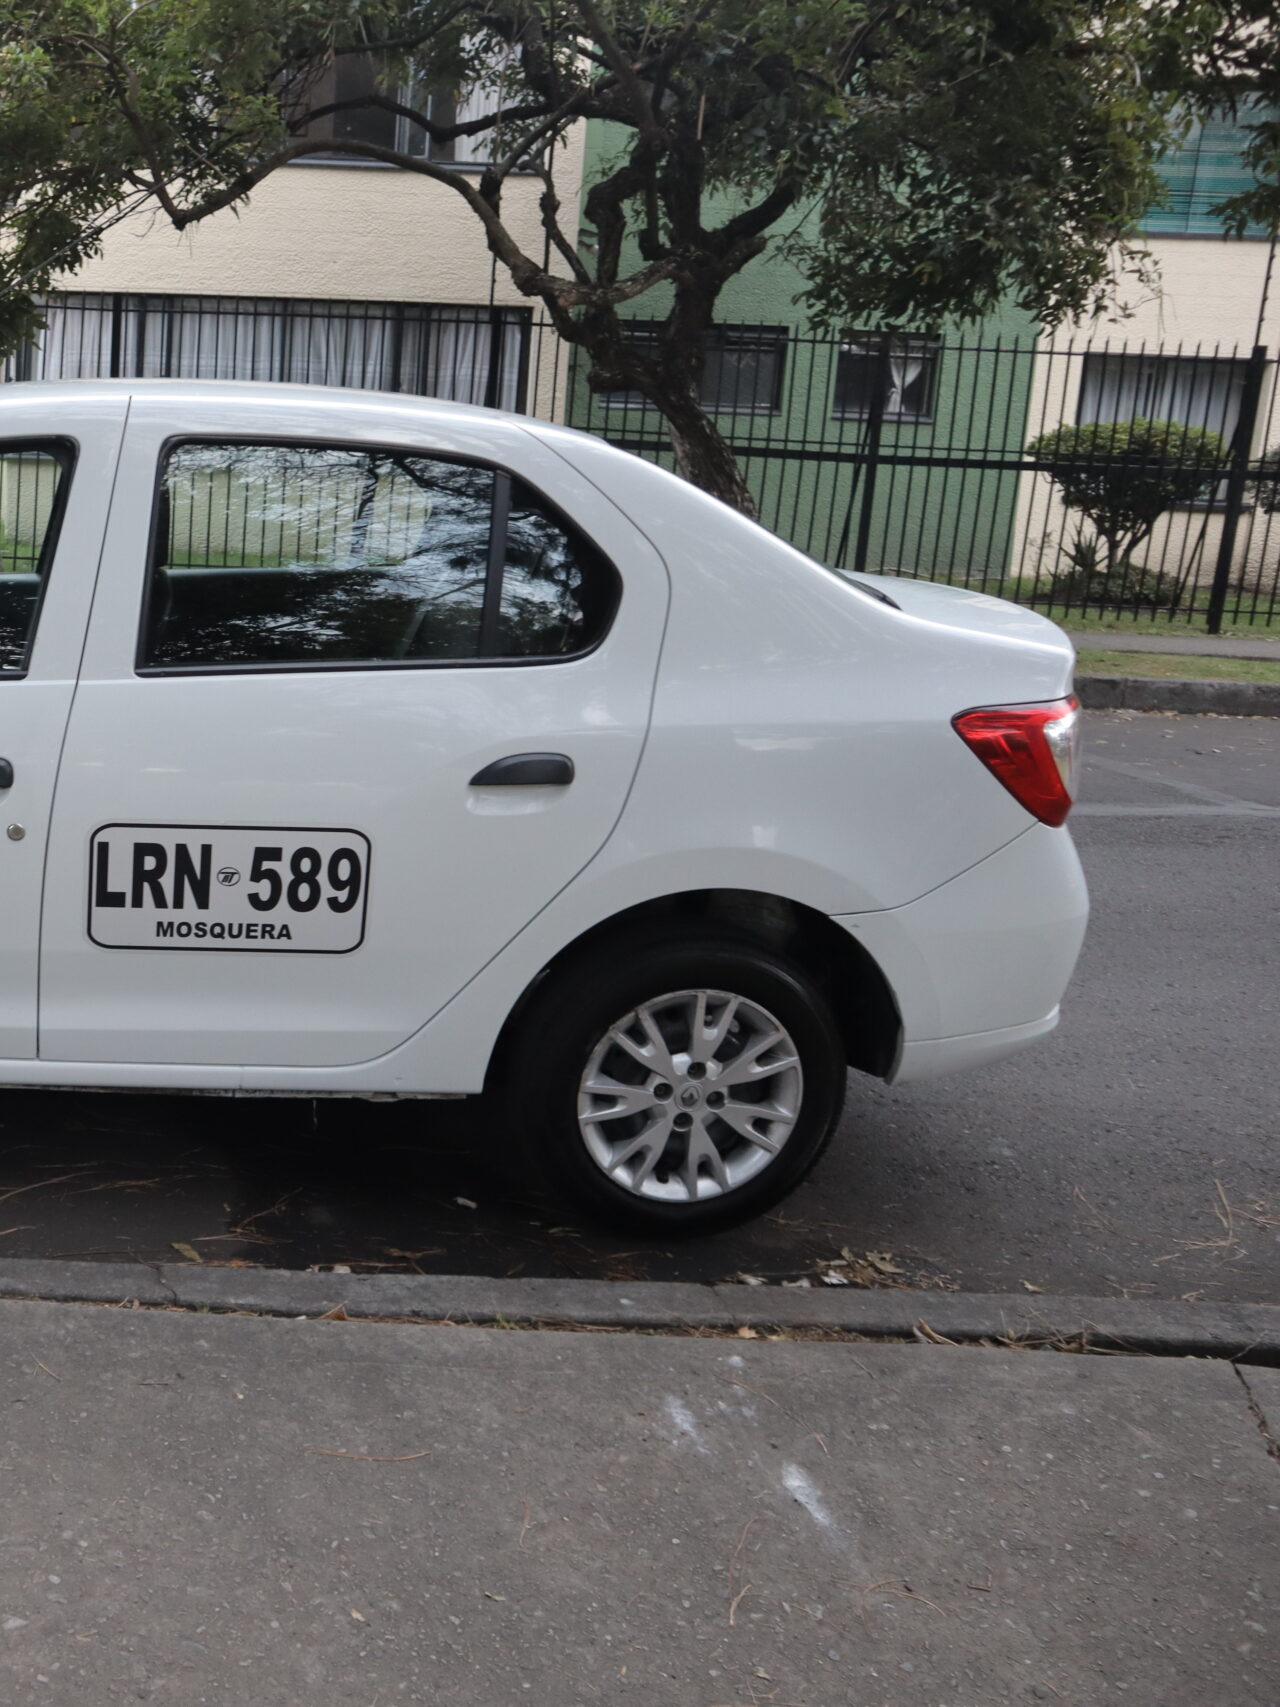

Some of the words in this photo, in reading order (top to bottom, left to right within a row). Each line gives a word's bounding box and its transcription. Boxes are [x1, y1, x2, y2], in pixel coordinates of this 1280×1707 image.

[95, 841, 212, 910] LRN
[247, 846, 362, 913] 589
[155, 921, 292, 940] MOSQUERA
